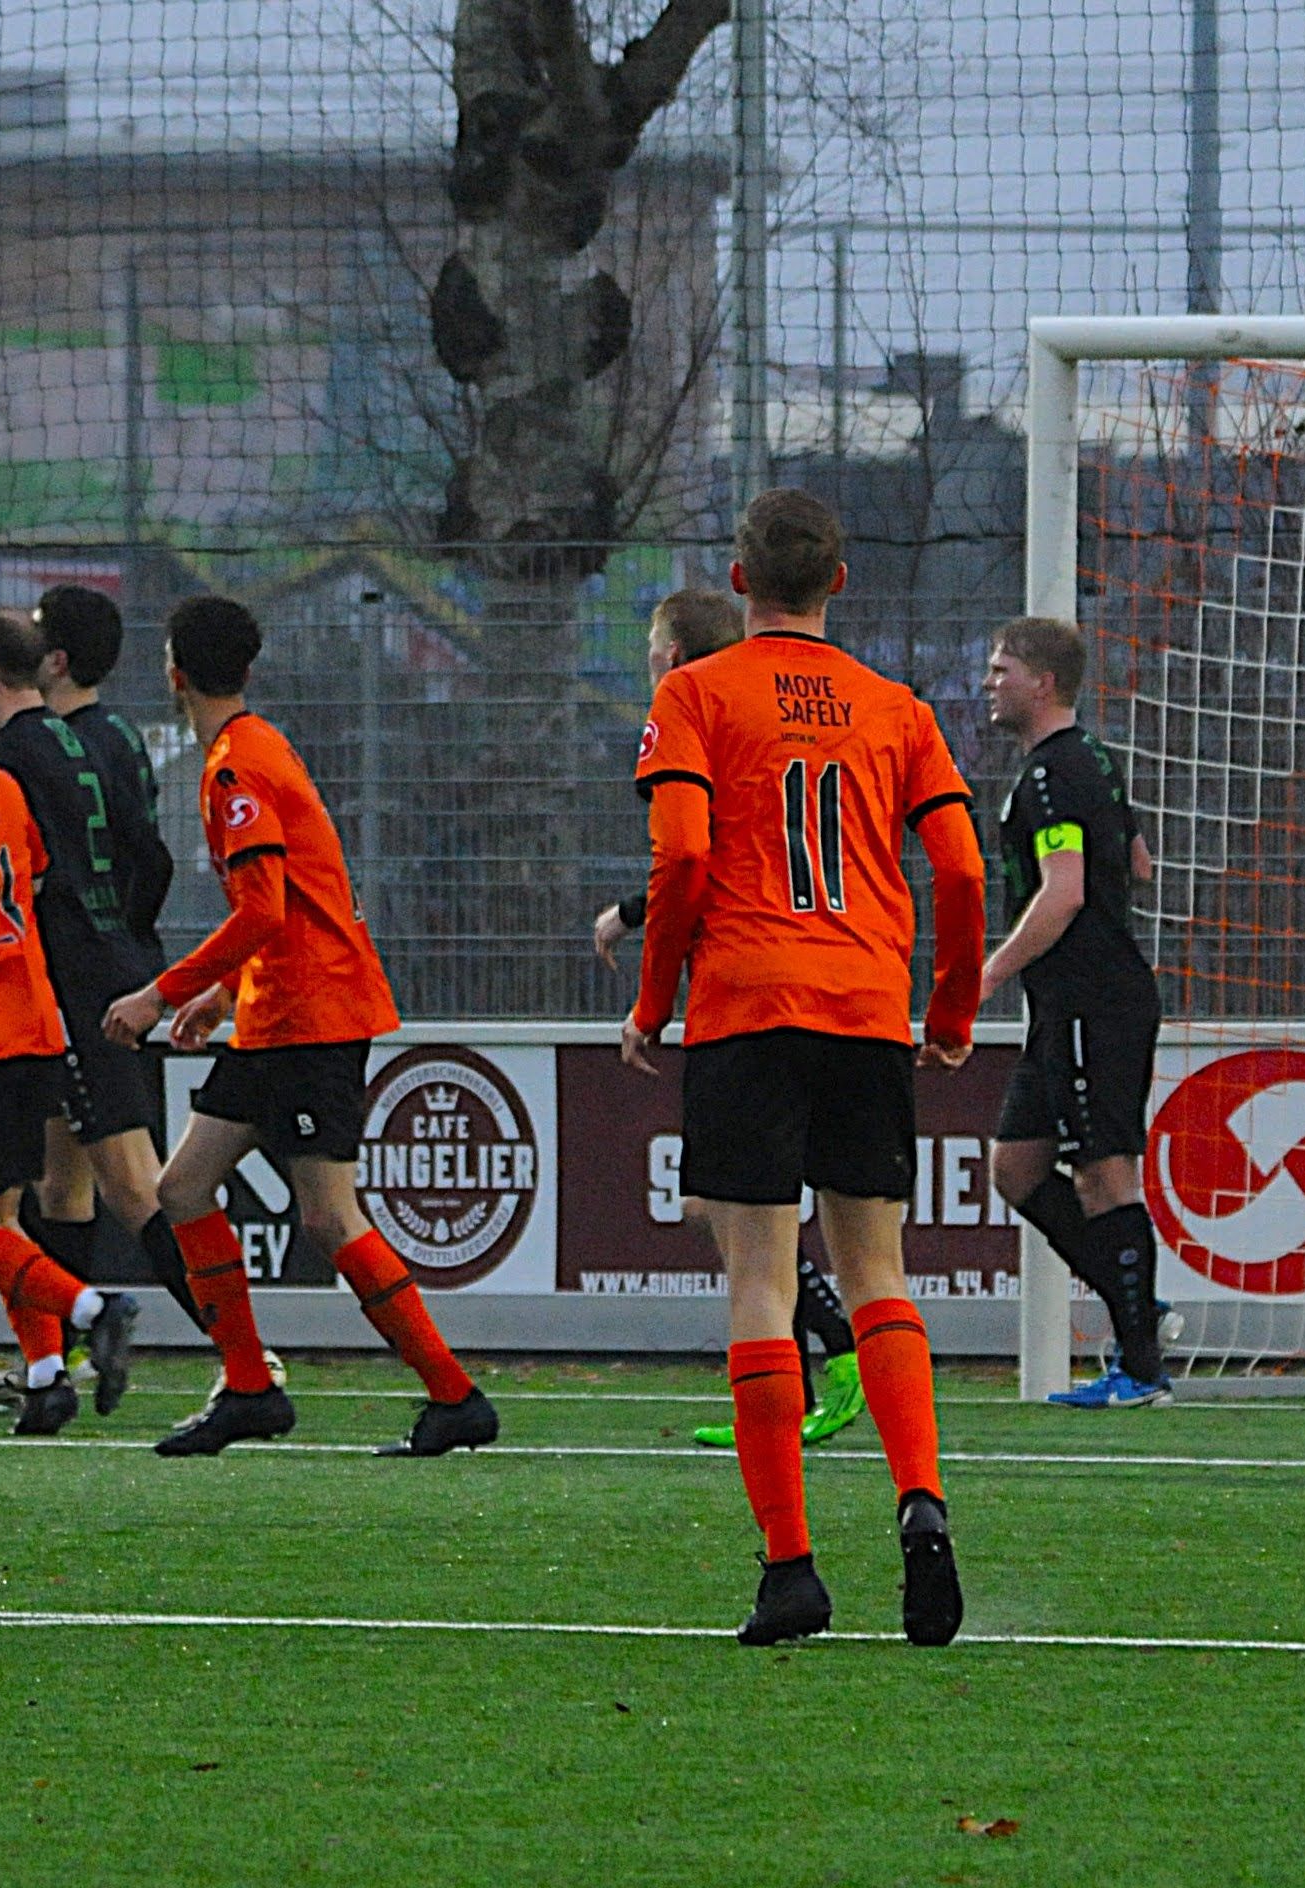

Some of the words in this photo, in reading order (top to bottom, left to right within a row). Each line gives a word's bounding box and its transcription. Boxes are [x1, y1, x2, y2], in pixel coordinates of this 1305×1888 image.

[775, 672, 837, 699] MOVE
[777, 697, 852, 727] SAFELY
[783, 758, 847, 912] 11
[412, 1114, 471, 1140] CAFE
[355, 1144, 535, 1189] SINGELIER
